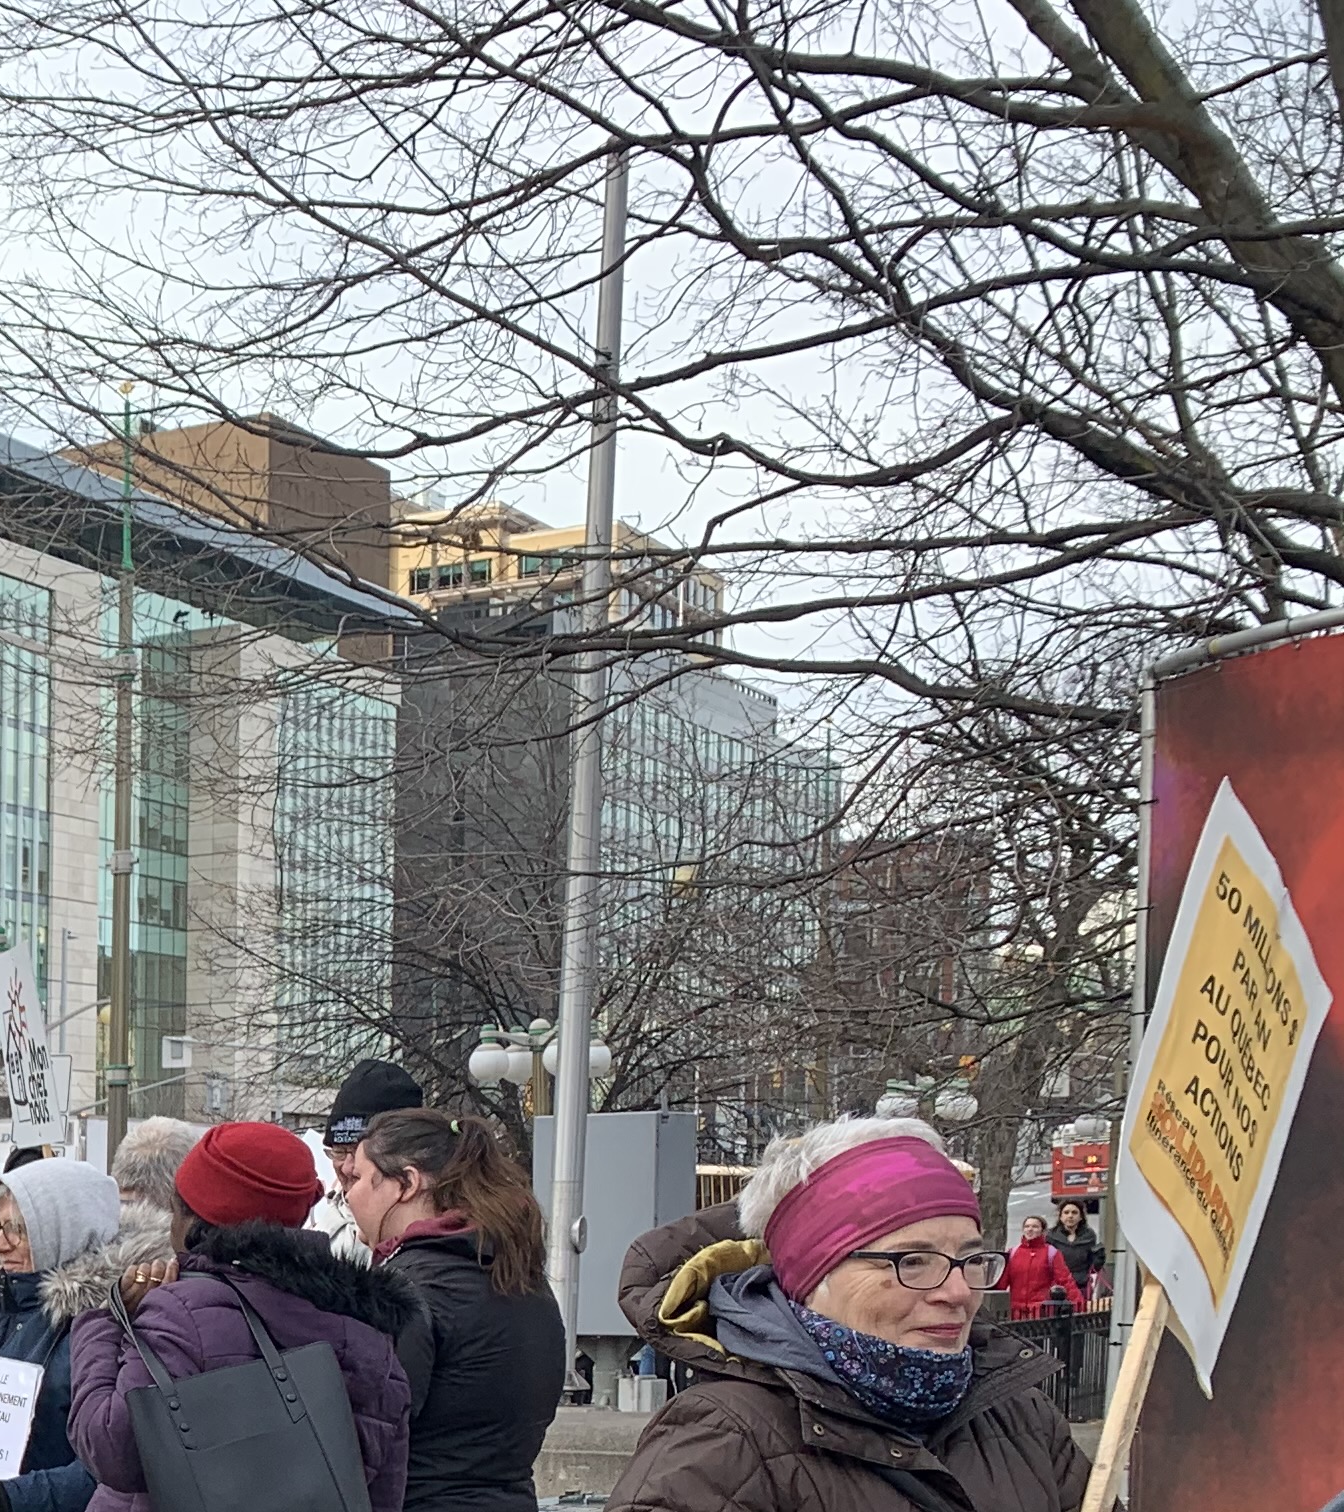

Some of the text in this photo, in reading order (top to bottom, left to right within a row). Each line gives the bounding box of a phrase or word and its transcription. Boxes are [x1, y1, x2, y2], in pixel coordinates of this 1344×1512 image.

[1216, 871, 1242, 914] 50
[1243, 904, 1292, 1026] MILLIONS
[1200, 973, 1231, 1016] AU
[1232, 948, 1271, 1052] PAR AN
[28, 1072, 48, 1100] chez
[29, 1099, 50, 1125] nous
[1157, 1079, 1198, 1138] Réseau
[1191, 1019, 1258, 1148] POUR NOS
[1146, 1109, 1196, 1188] Itinérance
[1184, 1075, 1244, 1182] ACTIONS
[0, 1374, 9, 1385] LE
